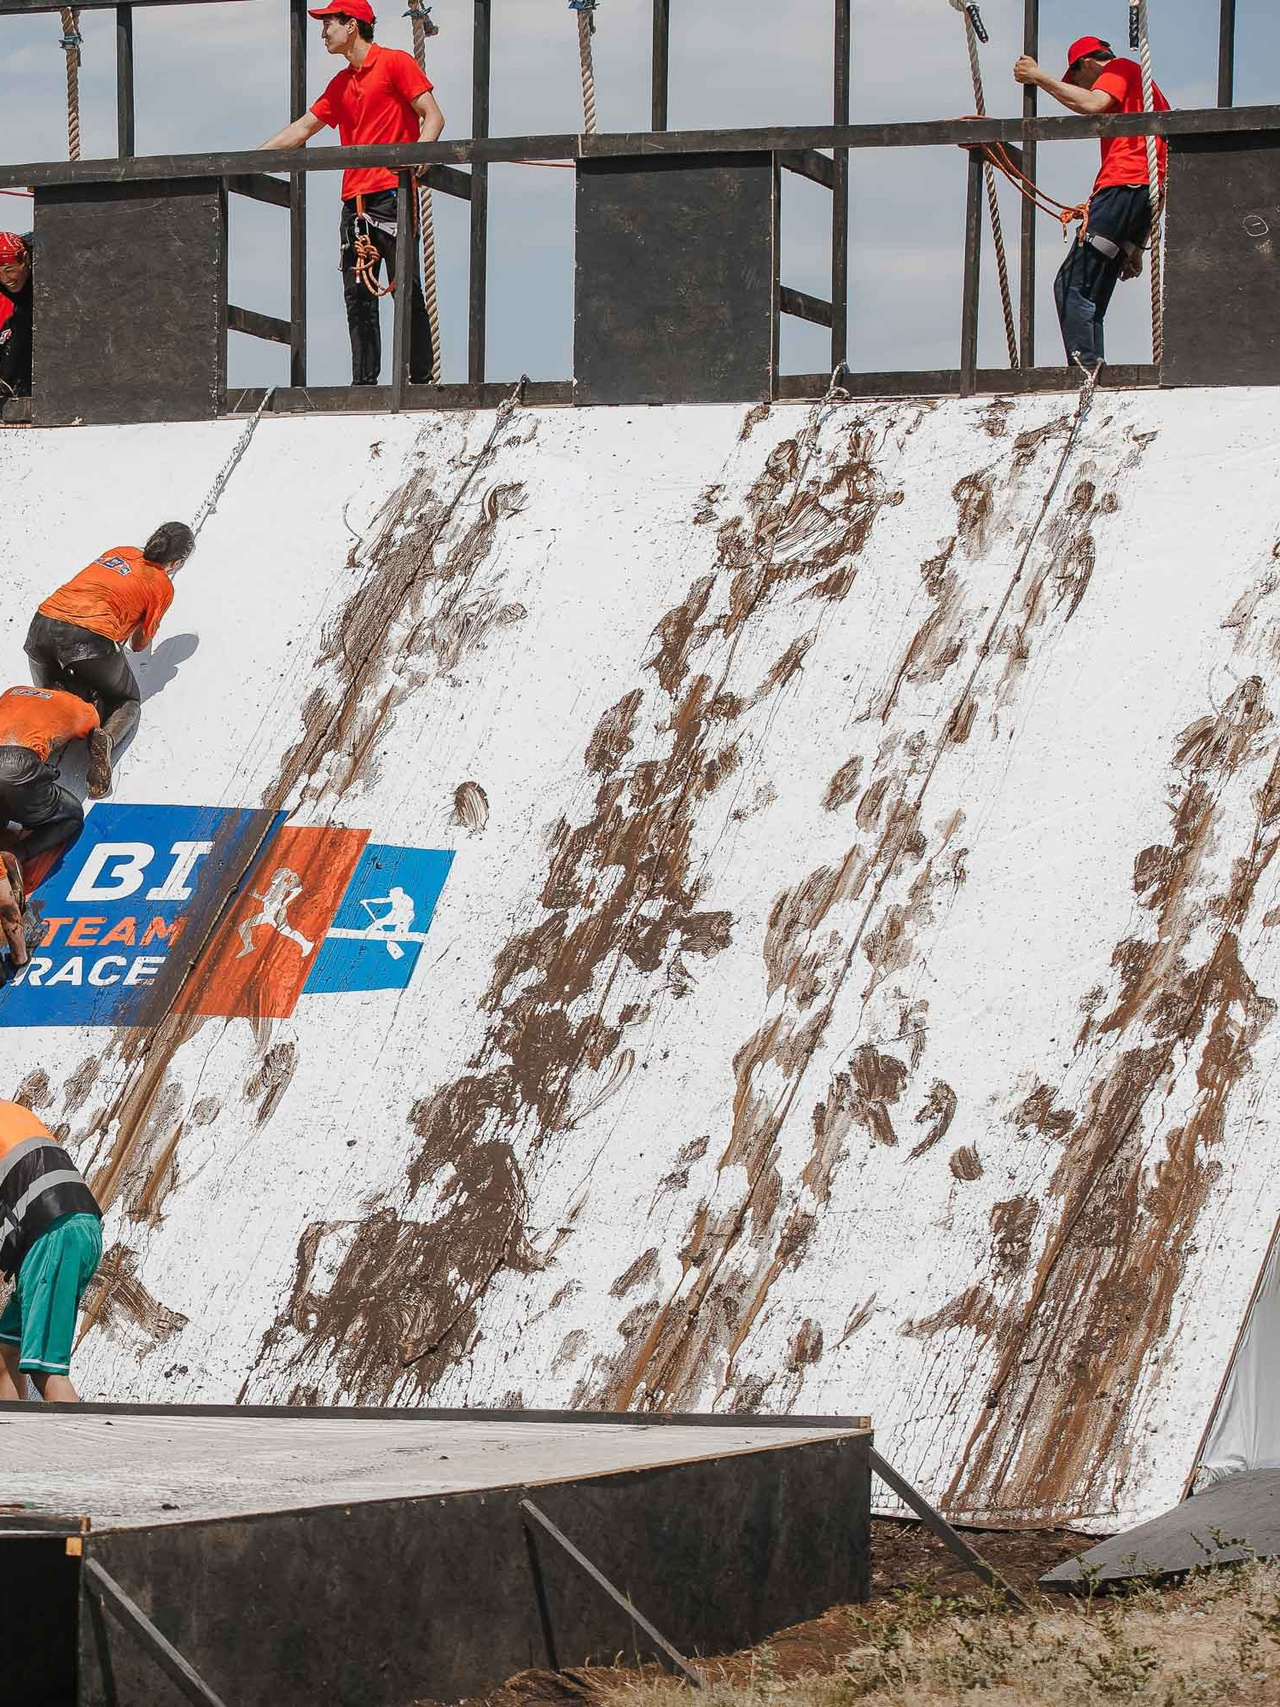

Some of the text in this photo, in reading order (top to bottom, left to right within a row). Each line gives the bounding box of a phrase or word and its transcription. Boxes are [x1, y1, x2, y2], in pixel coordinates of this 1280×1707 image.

[66, 841, 214, 901] BI
[40, 916, 187, 947] TEAM
[11, 955, 166, 986] RACE
